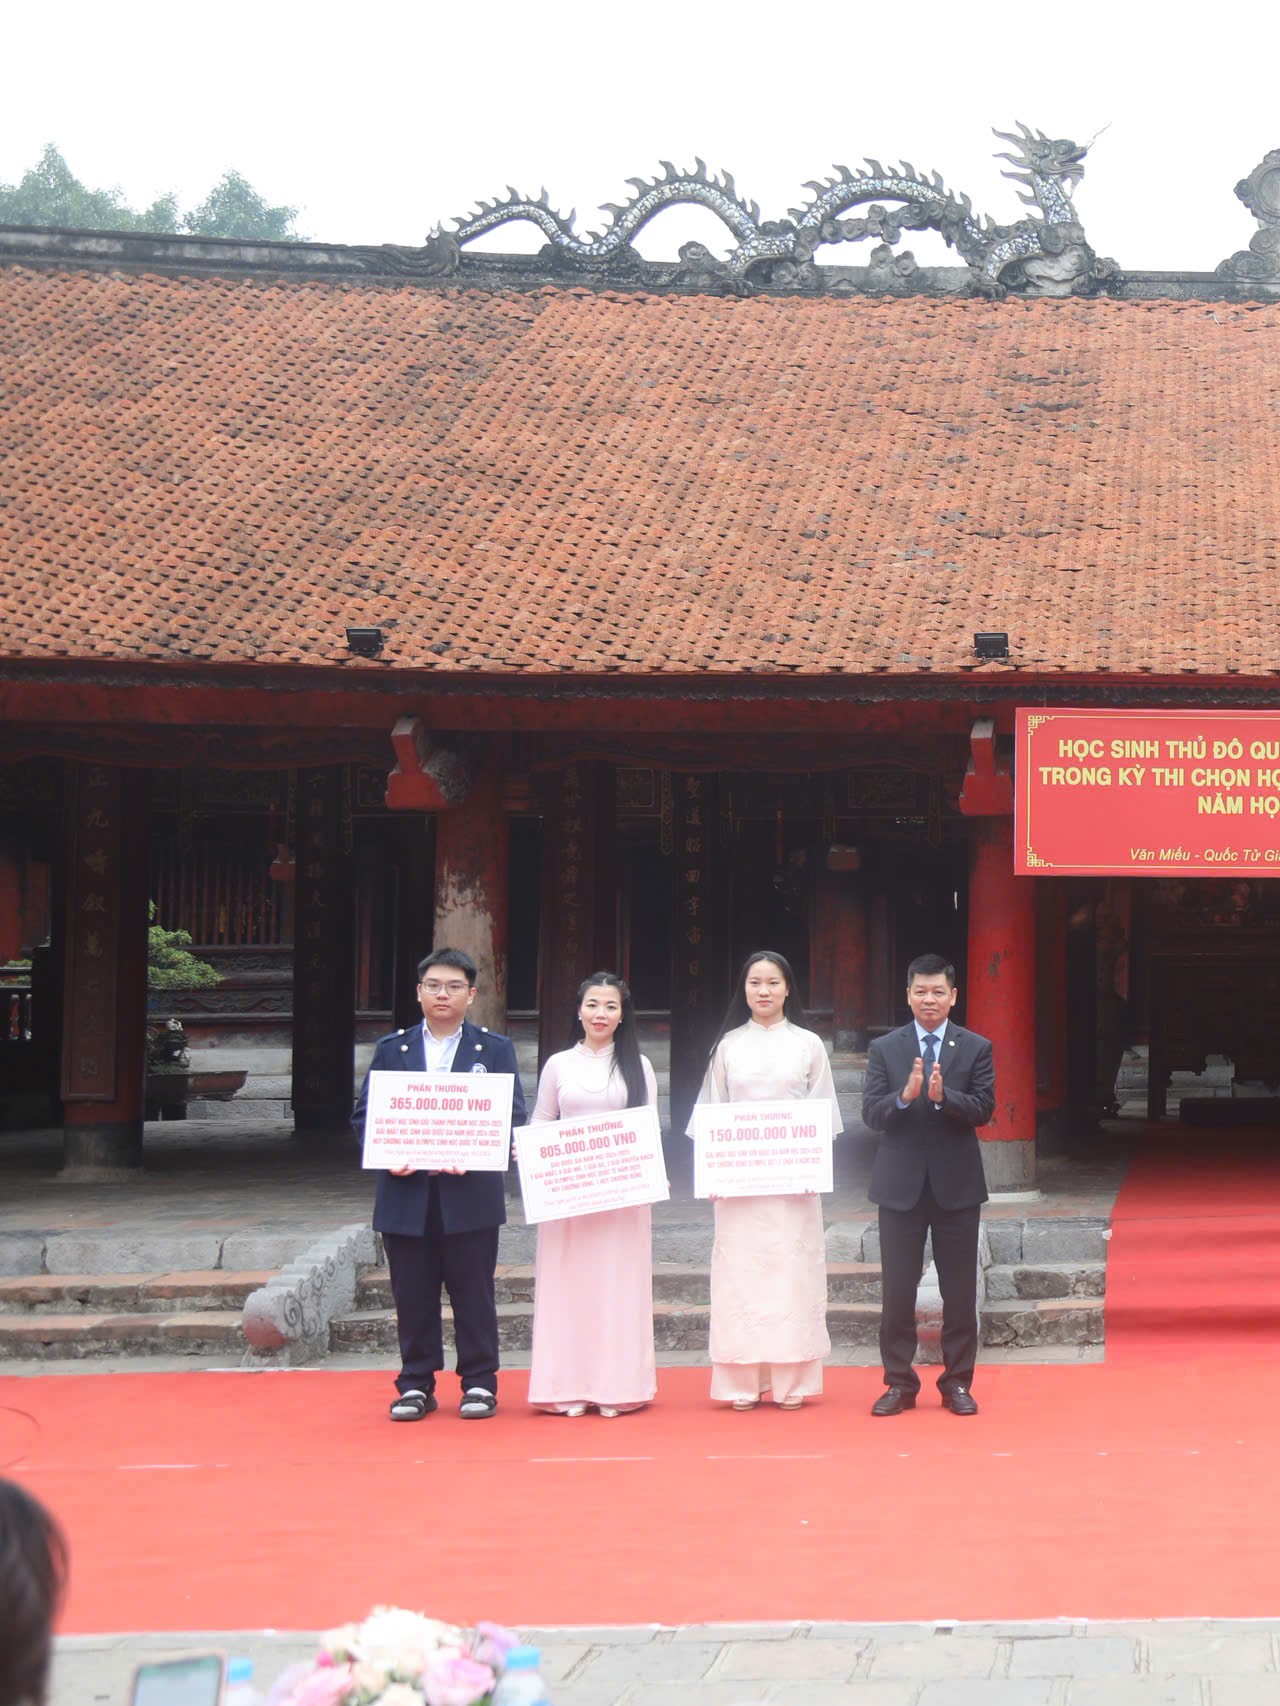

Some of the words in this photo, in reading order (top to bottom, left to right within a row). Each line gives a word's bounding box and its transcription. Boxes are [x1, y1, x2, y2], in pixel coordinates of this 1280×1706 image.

[1057, 738, 1106, 762] HỌC
[1110, 738, 1161, 759] SINH
[1164, 734, 1209, 760] THỦ
[1211, 736, 1245, 761] ĐÔ
[1040, 765, 1113, 787] TRONG
[1118, 764, 1146, 785] KỲ
[1152, 767, 1185, 787] THI
[1189, 767, 1252, 790] CHỌN
[1196, 793, 1245, 816] NĂM
[1130, 848, 1155, 861] Văn
[1158, 846, 1191, 861] Miếu
[1203, 846, 1239, 861] Quốc
[1243, 848, 1261, 861] Tử
[389, 1097, 463, 1111] 365.000.000
[467, 1098, 491, 1111] VNĐ
[540, 1136, 610, 1158] 805.000.000
[614, 1131, 637, 1145] VNĐ
[710, 1126, 787, 1142] 150.000.000
[791, 1125, 817, 1138] VNĐ
